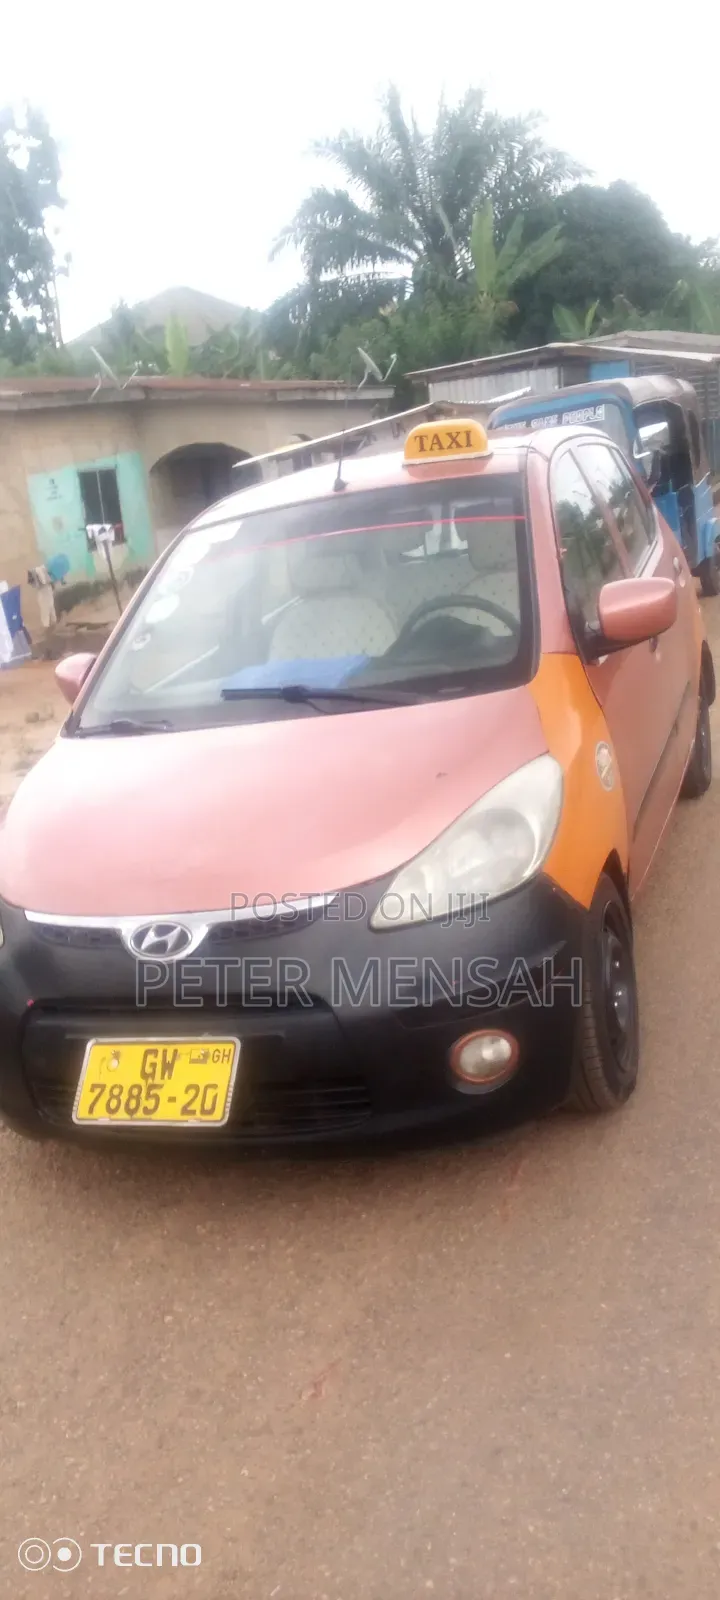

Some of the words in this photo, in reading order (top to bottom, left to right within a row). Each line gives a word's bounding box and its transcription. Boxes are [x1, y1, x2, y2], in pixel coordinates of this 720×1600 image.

[414, 430, 473, 453] TAXI
[140, 1048, 178, 1081] GW
[212, 1048, 231, 1064] GH
[87, 1083, 218, 1116] 7885-20
